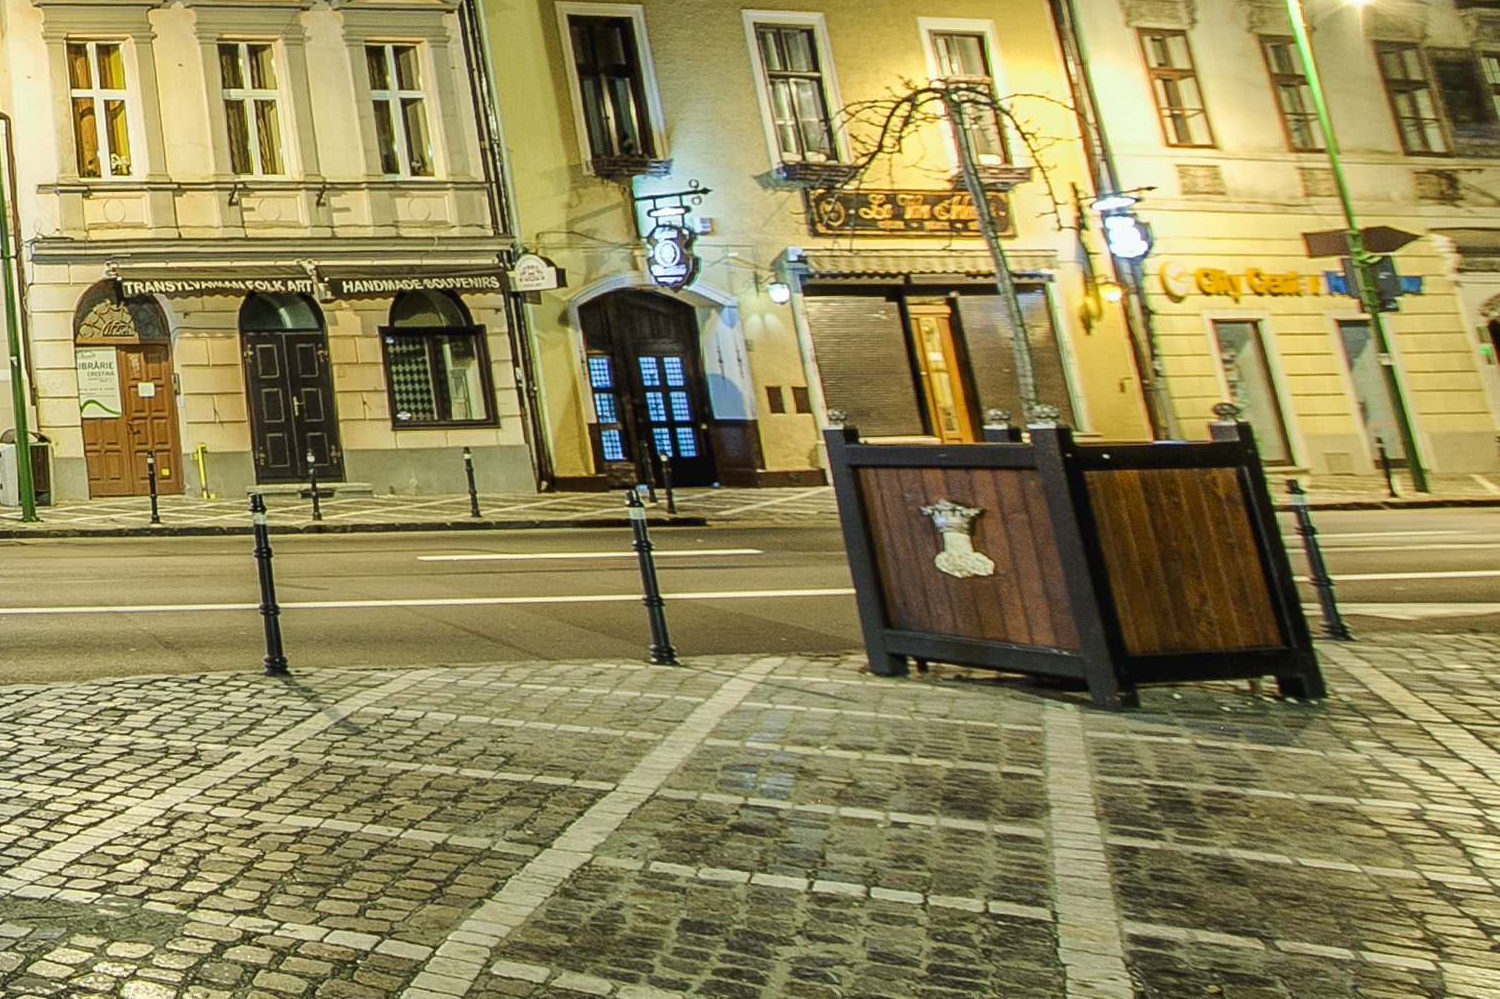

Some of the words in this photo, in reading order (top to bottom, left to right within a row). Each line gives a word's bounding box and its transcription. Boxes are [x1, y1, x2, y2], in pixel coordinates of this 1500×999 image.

[123, 280, 246, 294] TRANSYLVANIAN
[246, 279, 286, 291] FOLK
[287, 279, 313, 293] ART
[342, 279, 424, 293] HANDMADE
[424, 276, 500, 289] SOUVENIRS
[1245, 267, 1321, 297] Centr
[77, 361, 114, 370] IBRĂRIE
